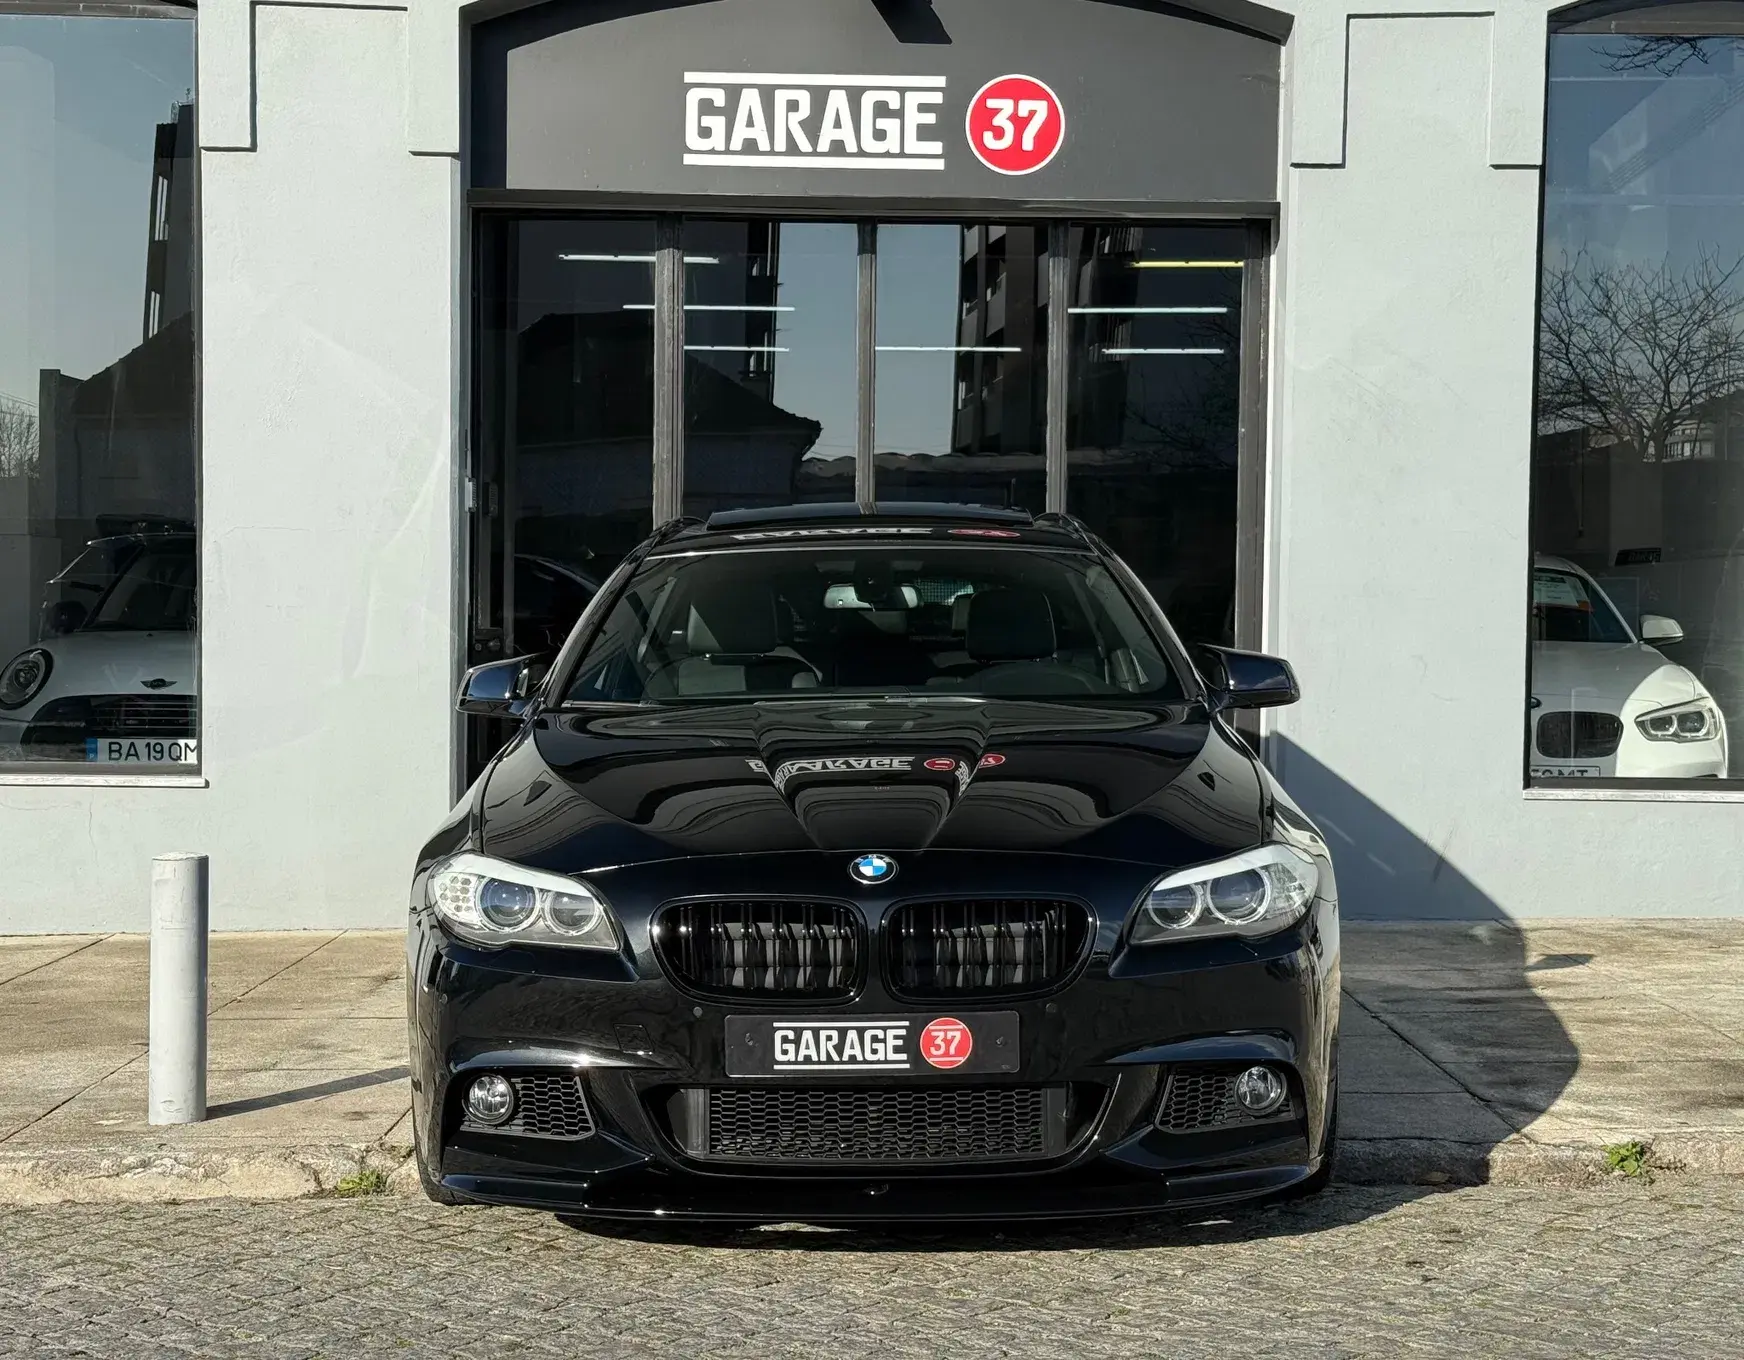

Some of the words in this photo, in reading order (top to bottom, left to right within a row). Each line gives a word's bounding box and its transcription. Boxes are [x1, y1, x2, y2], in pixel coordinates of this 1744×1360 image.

[685, 87, 943, 155] GARAGE
[982, 97, 1049, 152] 37
[108, 741, 140, 761] BA
[145, 741, 165, 762] 19
[168, 742, 197, 762] QM
[774, 1029, 907, 1062] GARAGE
[929, 1031, 962, 1056] 37
